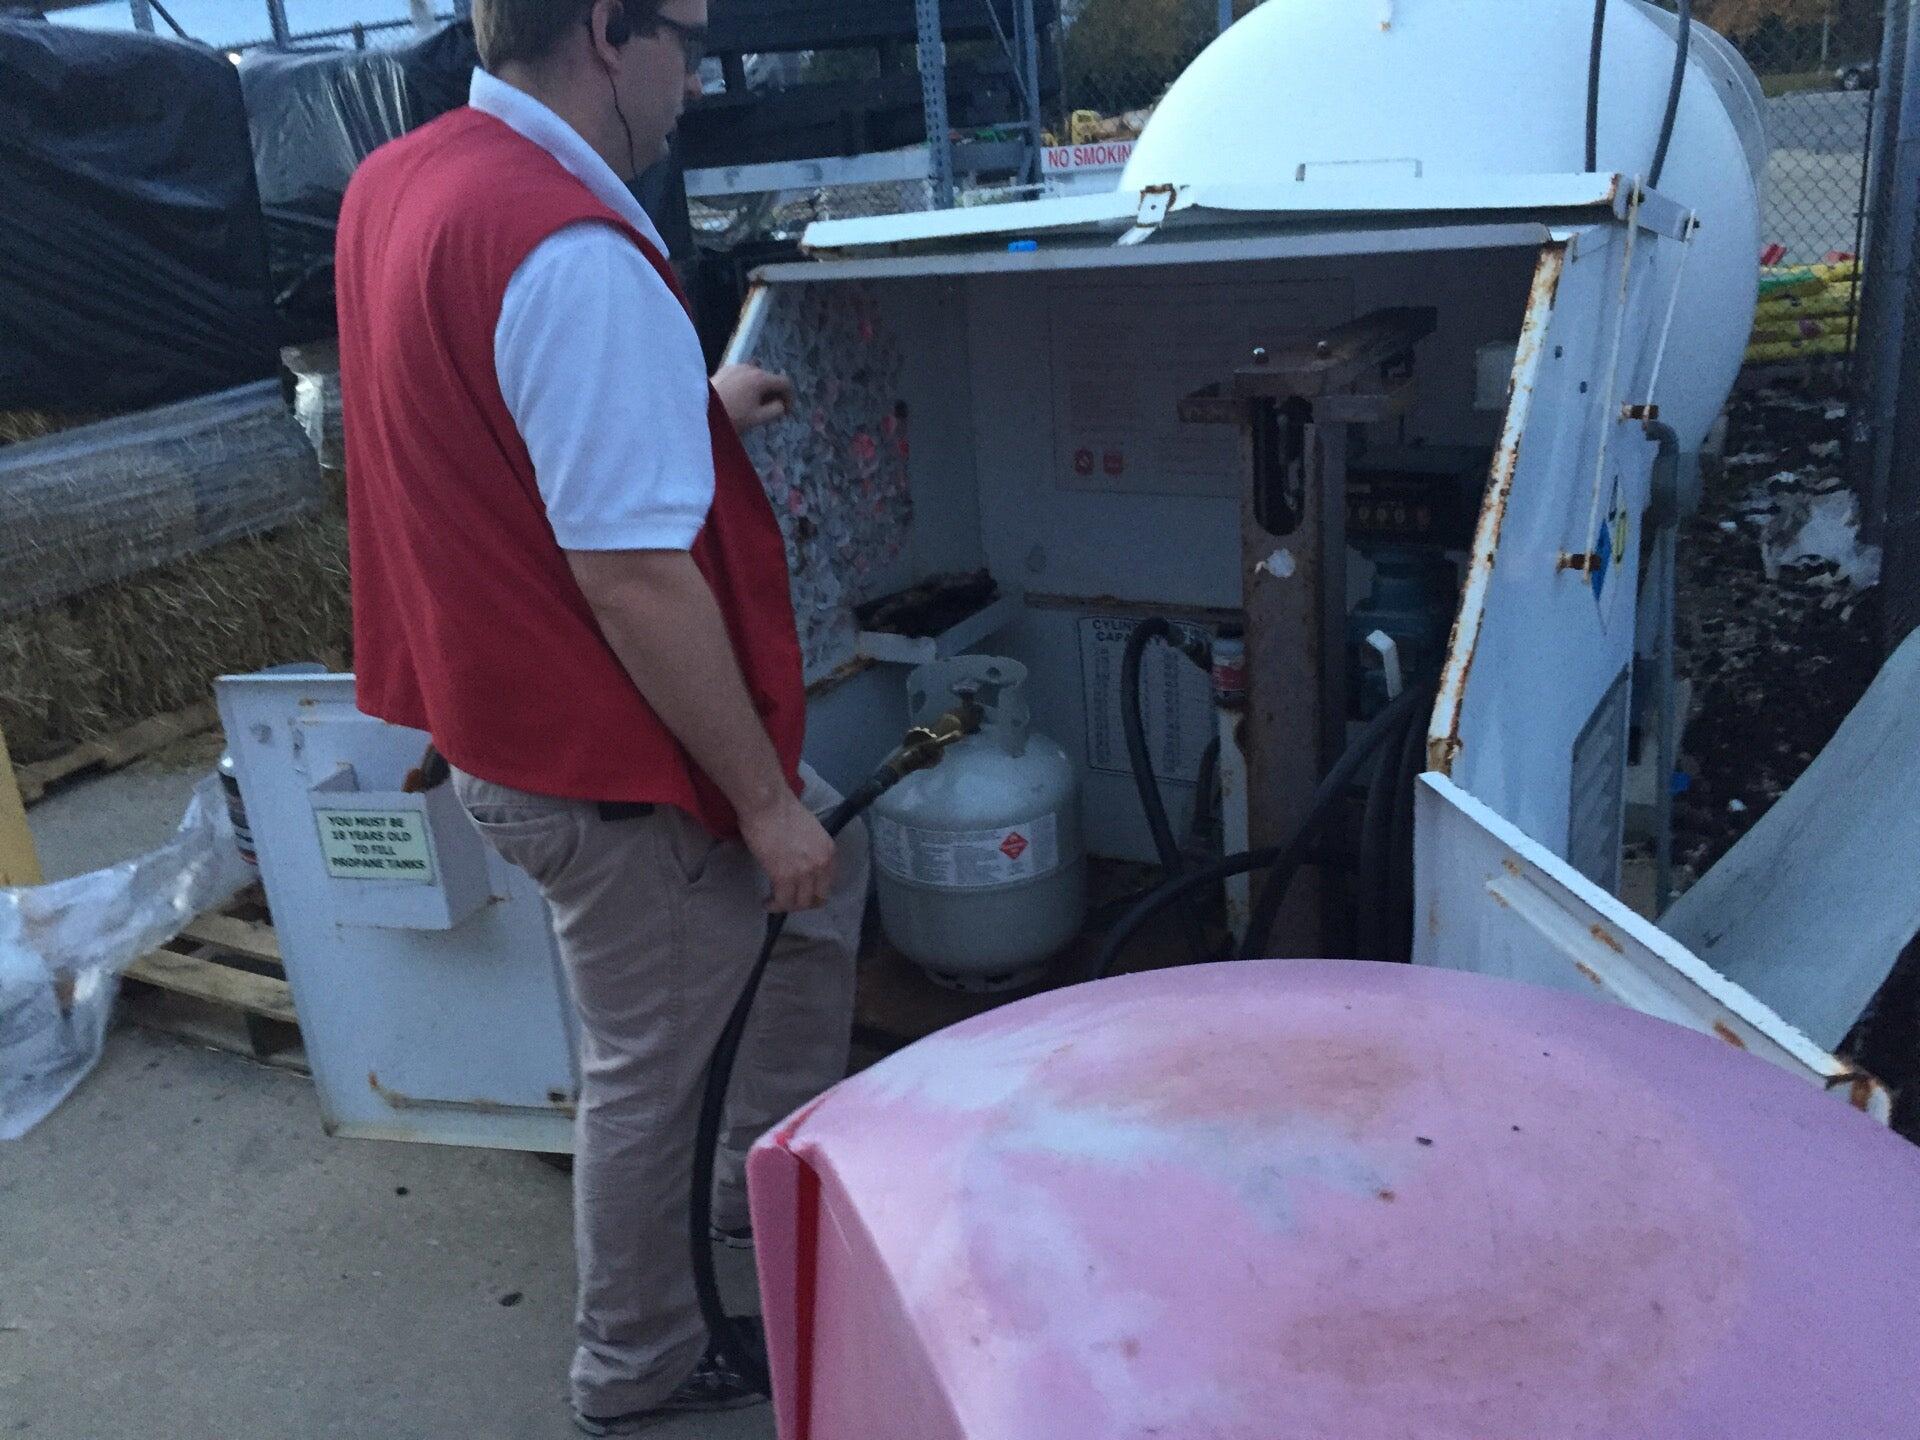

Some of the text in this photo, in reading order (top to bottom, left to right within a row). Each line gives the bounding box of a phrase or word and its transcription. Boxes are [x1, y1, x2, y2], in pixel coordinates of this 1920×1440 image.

[1048, 143, 1132, 168] NO SMOKIN
[327, 816, 404, 828] YOU MUST BE
[332, 830, 412, 841] 18 YEARS OLD
[352, 844, 396, 855] TO FILL
[331, 857, 426, 869] PROPANE TANKS
